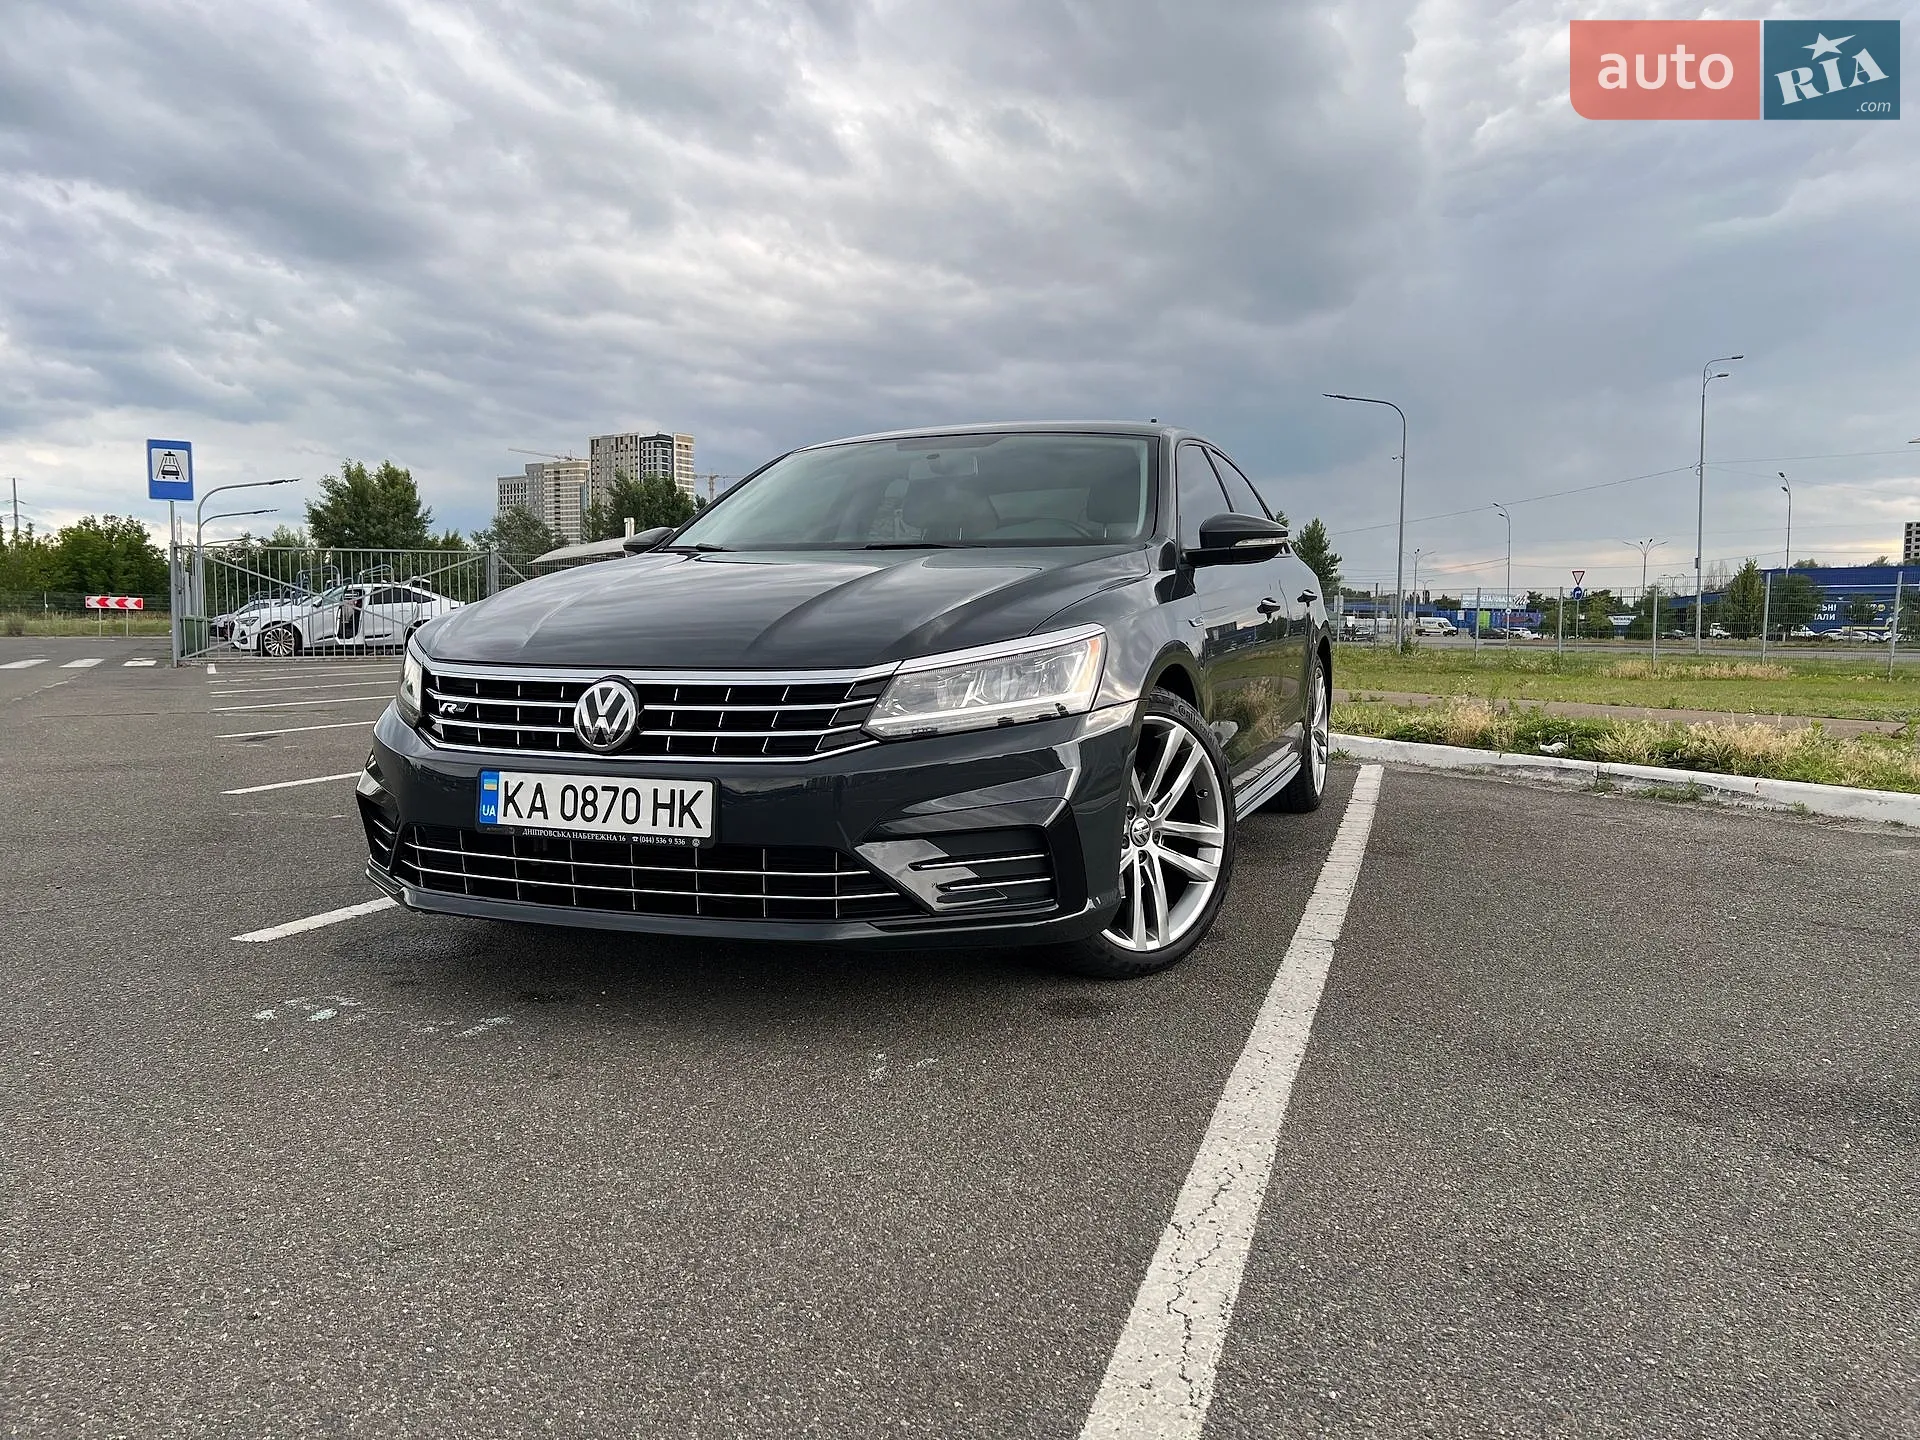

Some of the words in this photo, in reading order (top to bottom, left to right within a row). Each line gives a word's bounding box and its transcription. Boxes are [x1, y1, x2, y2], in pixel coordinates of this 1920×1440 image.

[482, 805, 497, 817] UA
[502, 780, 549, 820] KA
[560, 784, 641, 824] 0870
[652, 788, 703, 829] HK
[522, 828, 571, 838] ДНІПРОВСЬКА
[572, 832, 617, 842] НАБЕРЕЖНА
[655, 837, 667, 845] 536
[674, 838, 686, 846] 536
